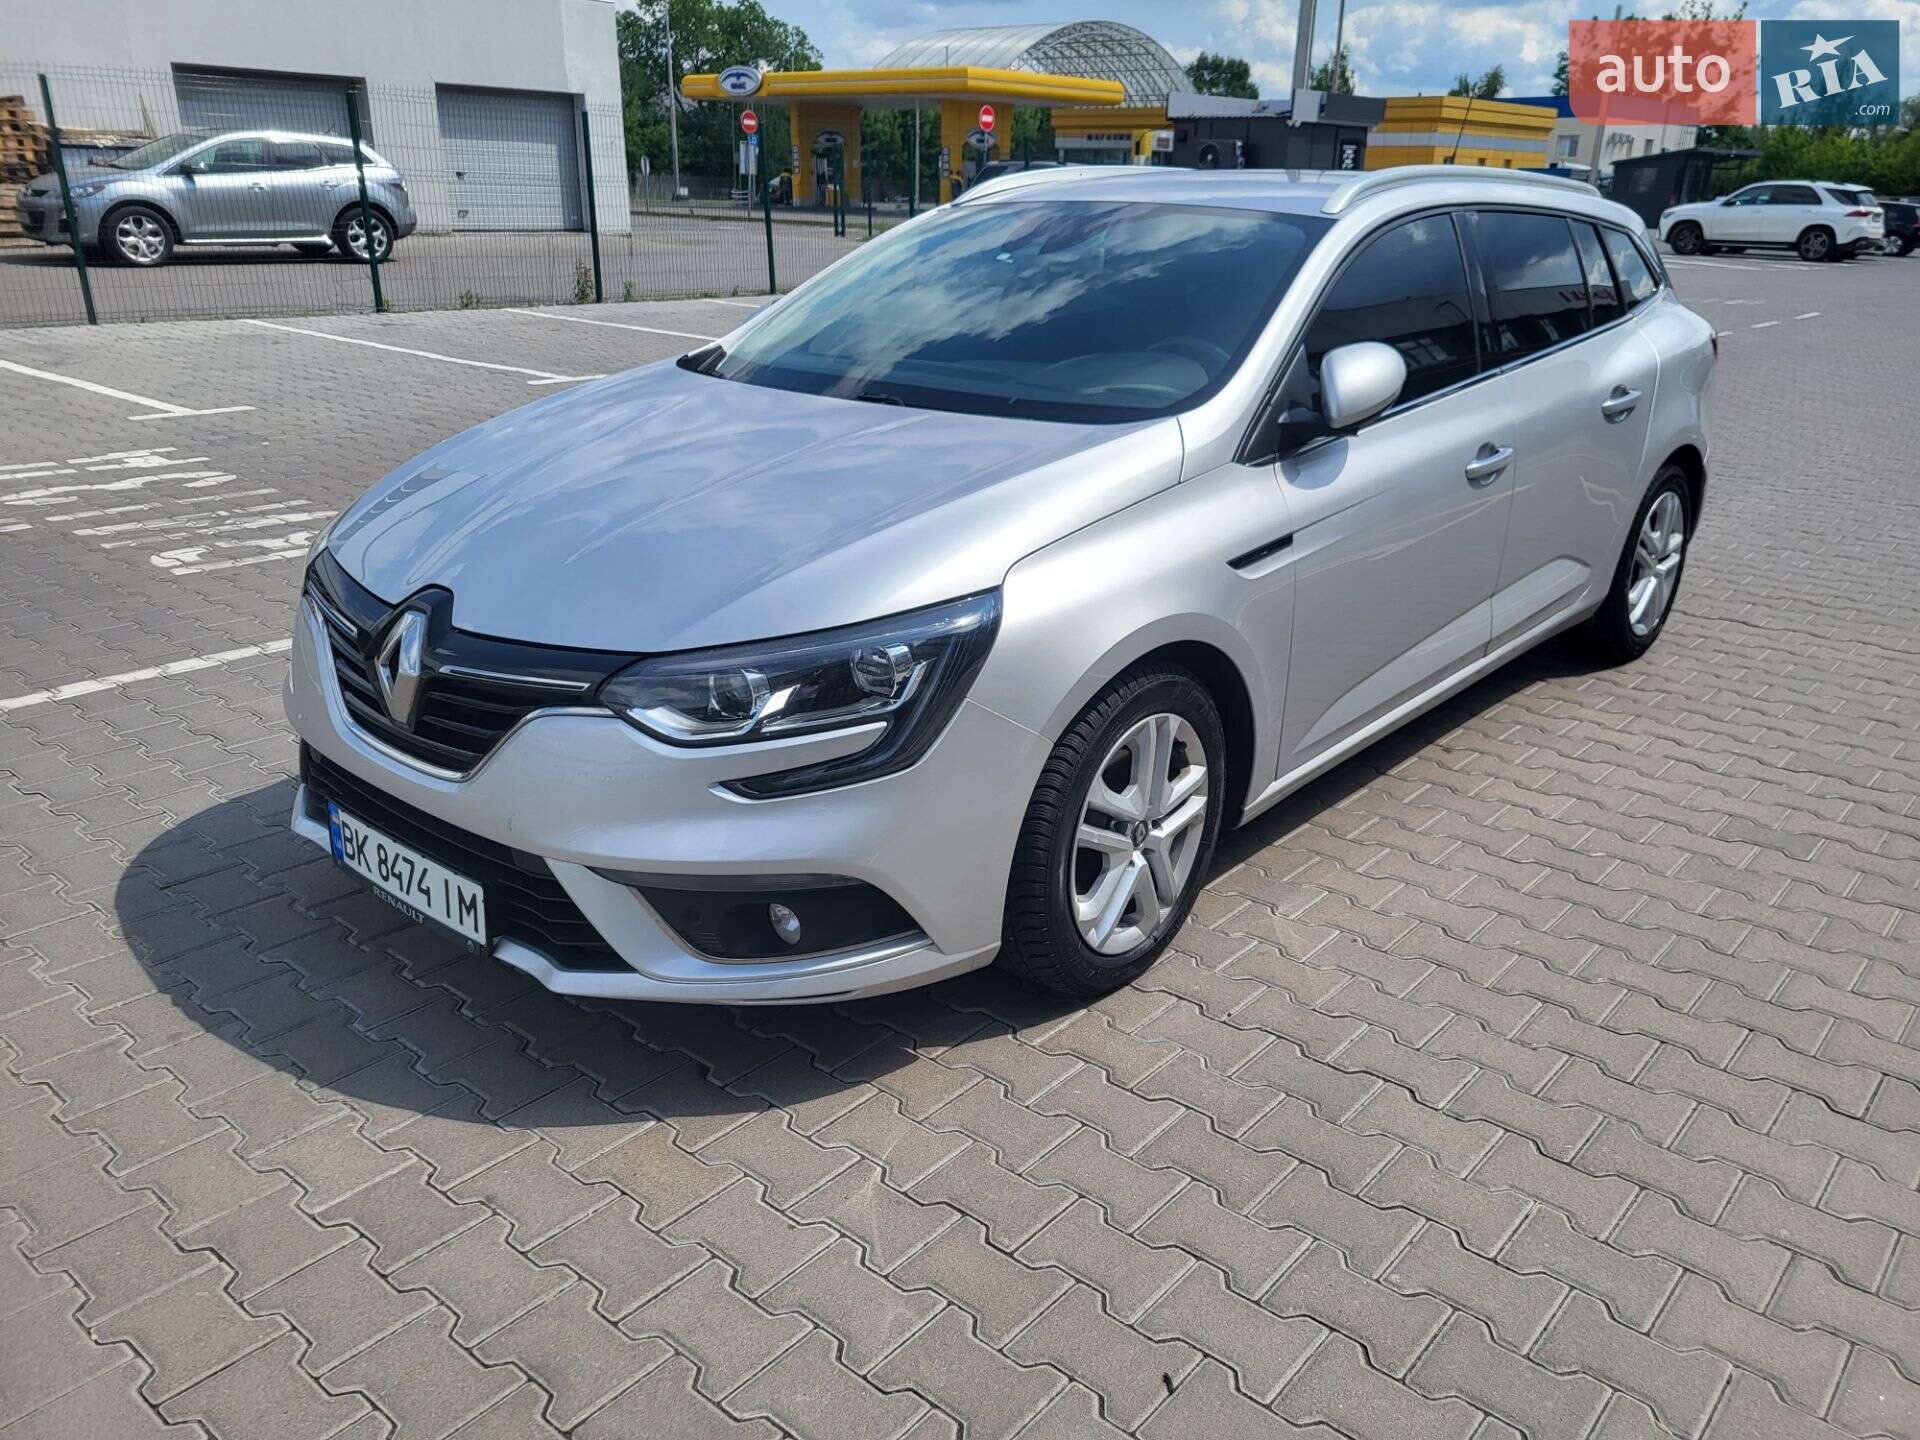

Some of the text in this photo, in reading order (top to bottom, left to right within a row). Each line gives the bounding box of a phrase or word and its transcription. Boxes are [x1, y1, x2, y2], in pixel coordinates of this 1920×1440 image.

[341, 820, 480, 934] BK 8474 IM
[373, 885, 425, 924] RENAULT
